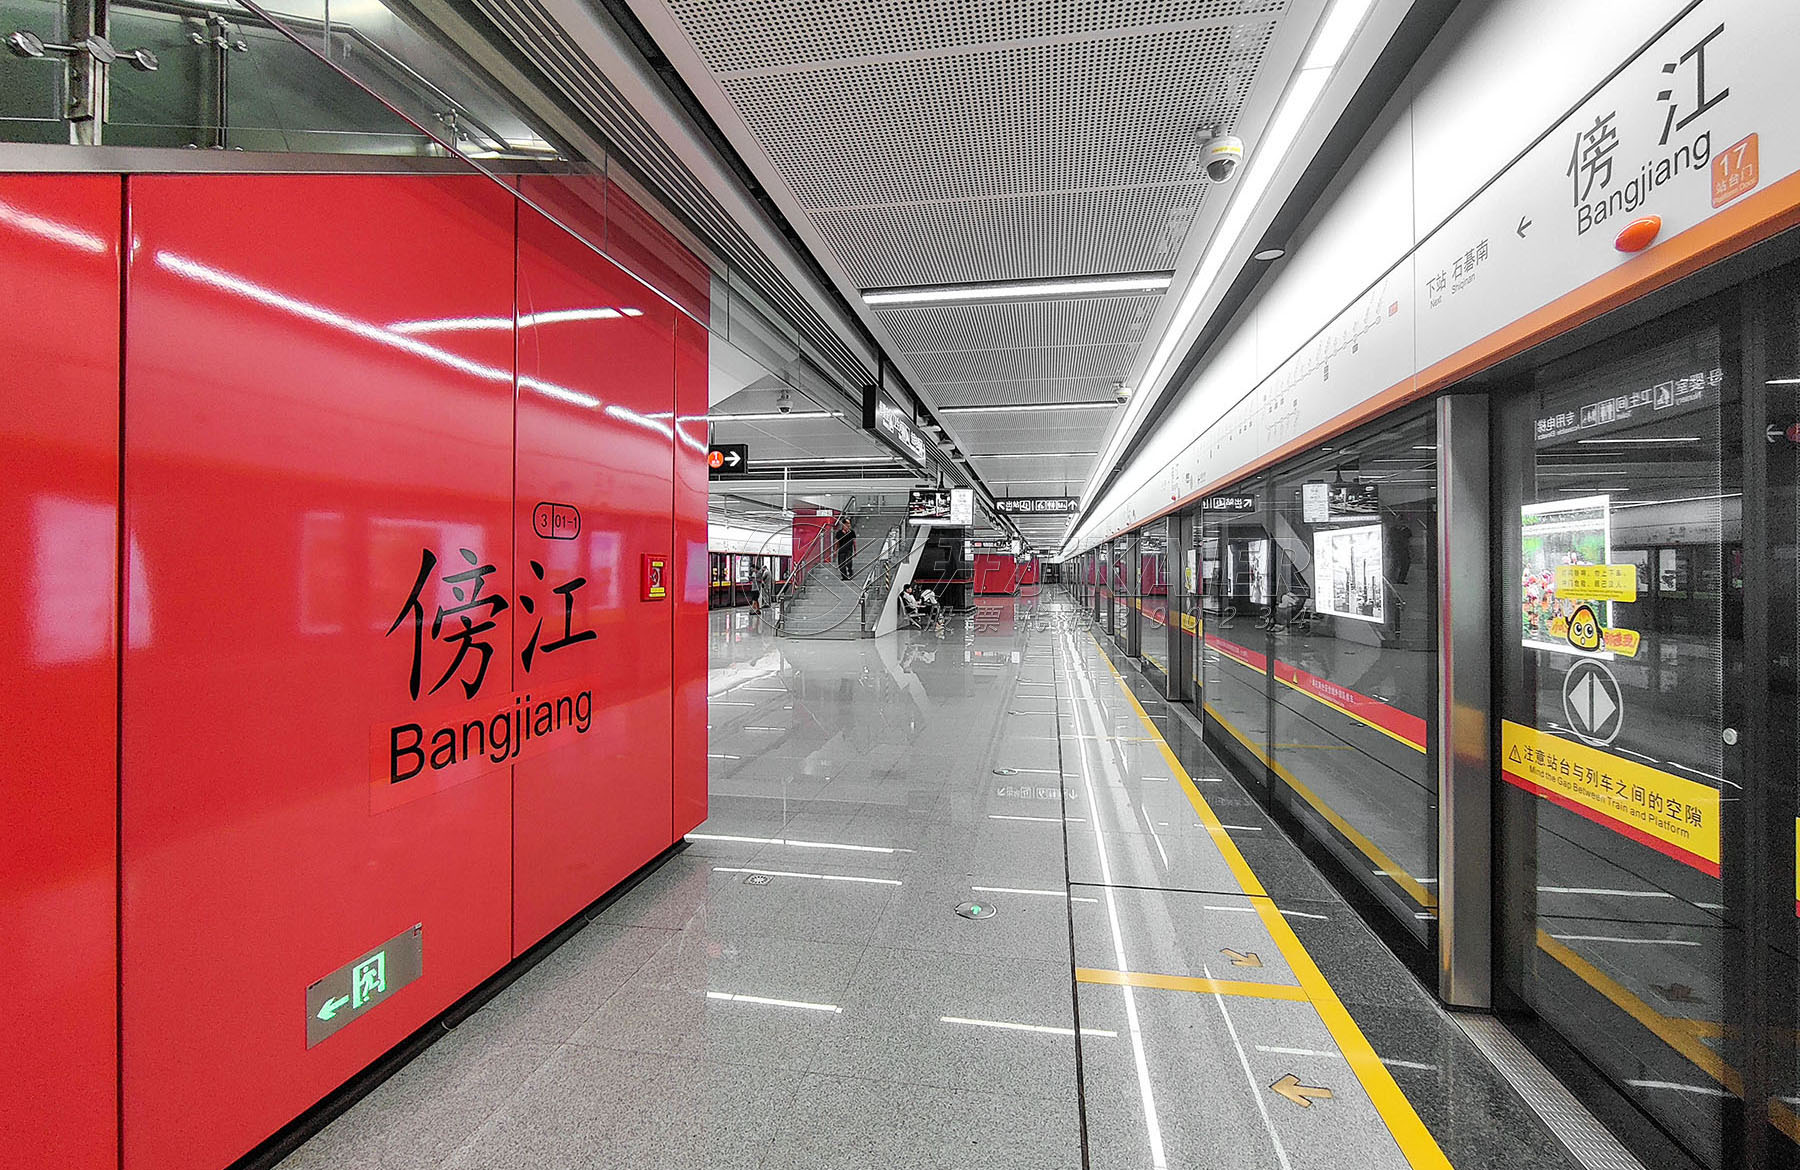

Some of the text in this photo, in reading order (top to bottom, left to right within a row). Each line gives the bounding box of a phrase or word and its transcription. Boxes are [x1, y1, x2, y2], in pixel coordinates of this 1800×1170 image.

[1566, 22, 1730, 207] 傍江
[1578, 131, 1712, 236] Bangjiang
[1716, 164, 1753, 194] 站台门
[1720, 142, 1748, 177] 17
[1426, 238, 1489, 298] 下站 石碁南
[541, 513, 577, 529] 3 01-1
[386, 548, 598, 702] 傍江
[389, 690, 593, 785] Bangjiang
[1523, 744, 1703, 829] 注意站台与列车之间的空隙
[1529, 765, 1690, 839] Mind the Gap Between Train and Platform
